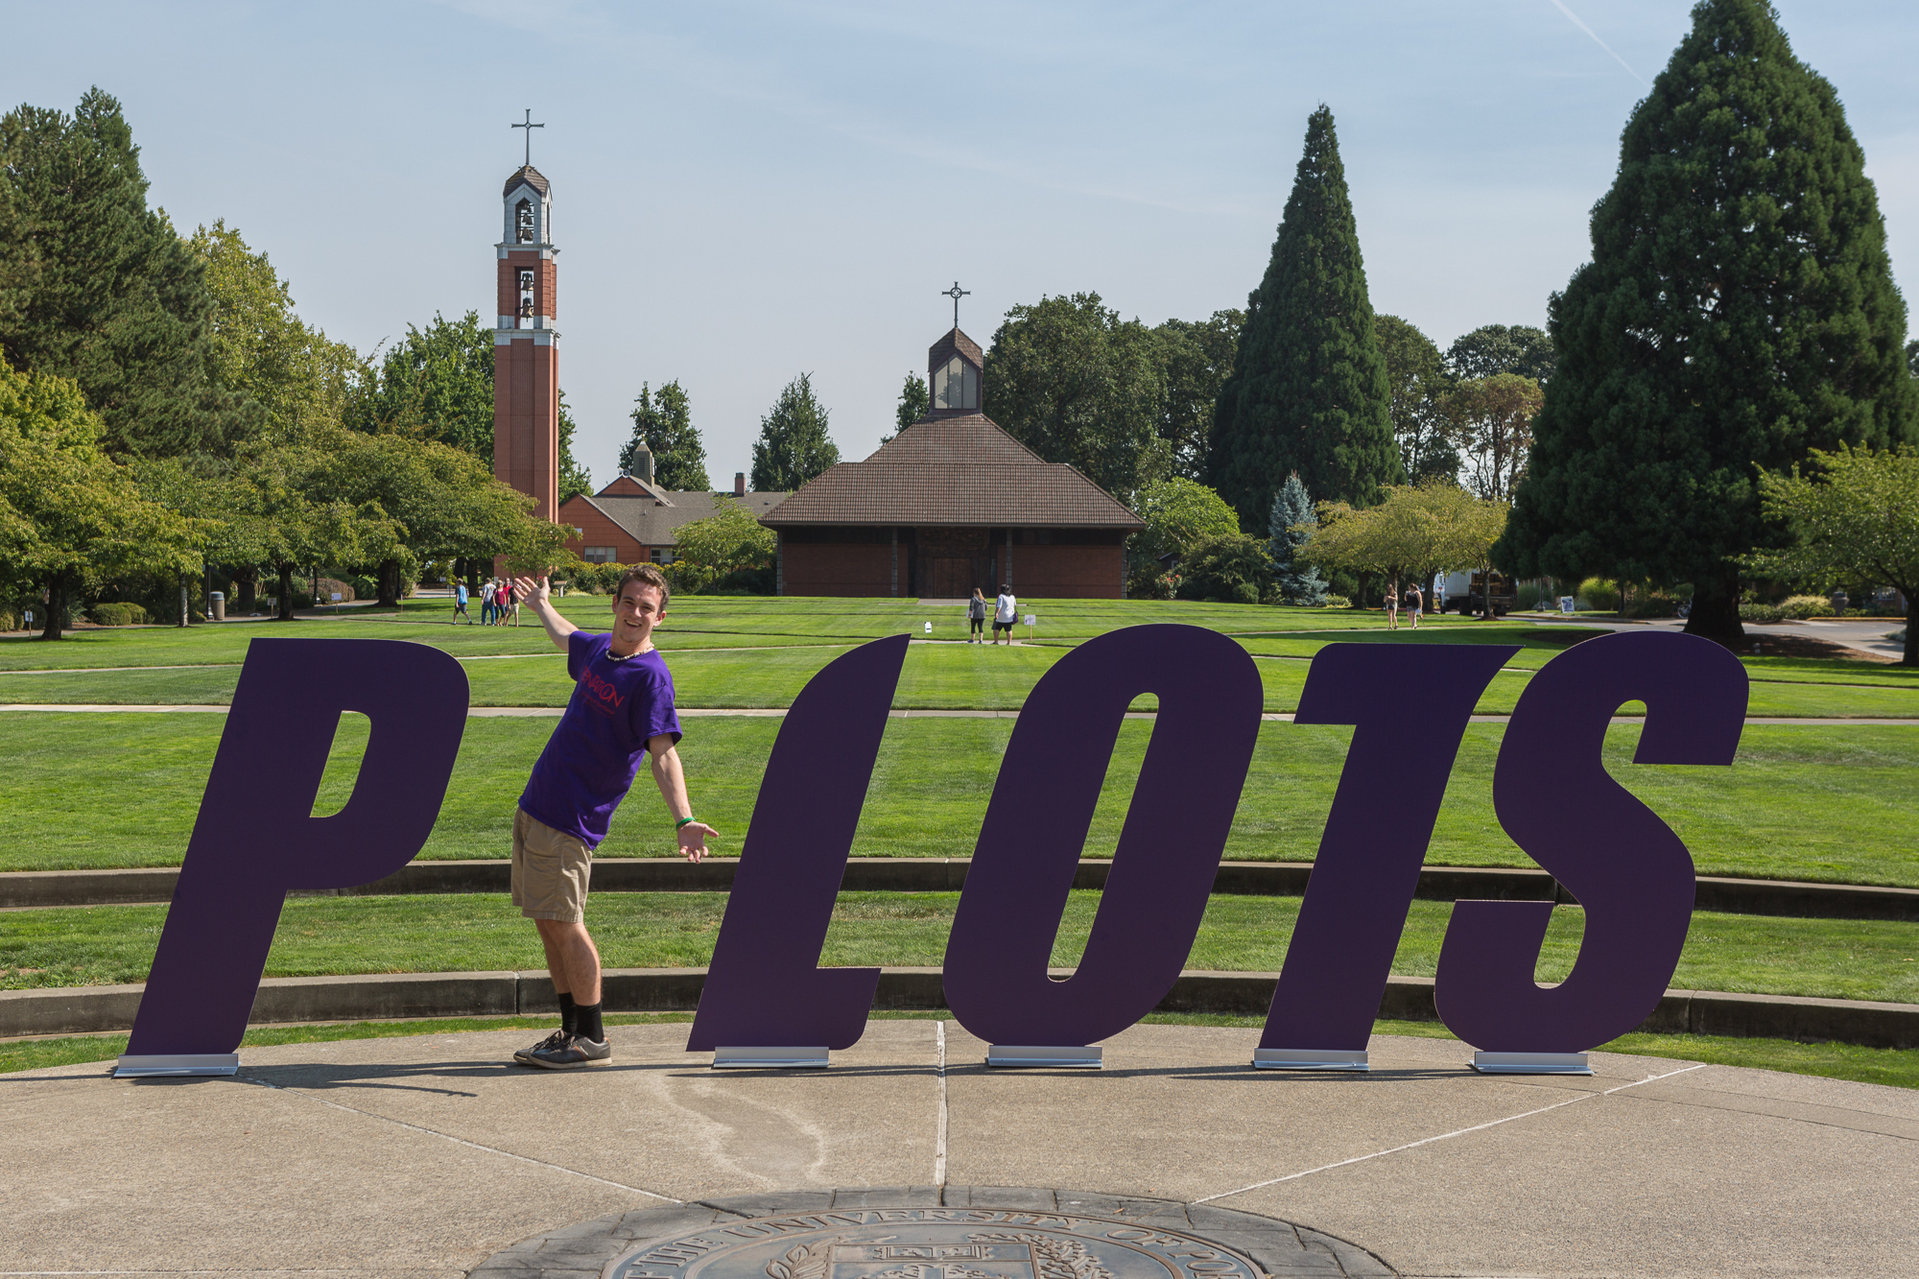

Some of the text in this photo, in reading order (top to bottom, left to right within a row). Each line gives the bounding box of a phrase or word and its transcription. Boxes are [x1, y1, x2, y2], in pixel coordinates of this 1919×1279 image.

[631, 1237, 731, 1268] THE
[719, 1210, 1102, 1239] UNIVERSITY
[1106, 1229, 1188, 1247] OF
